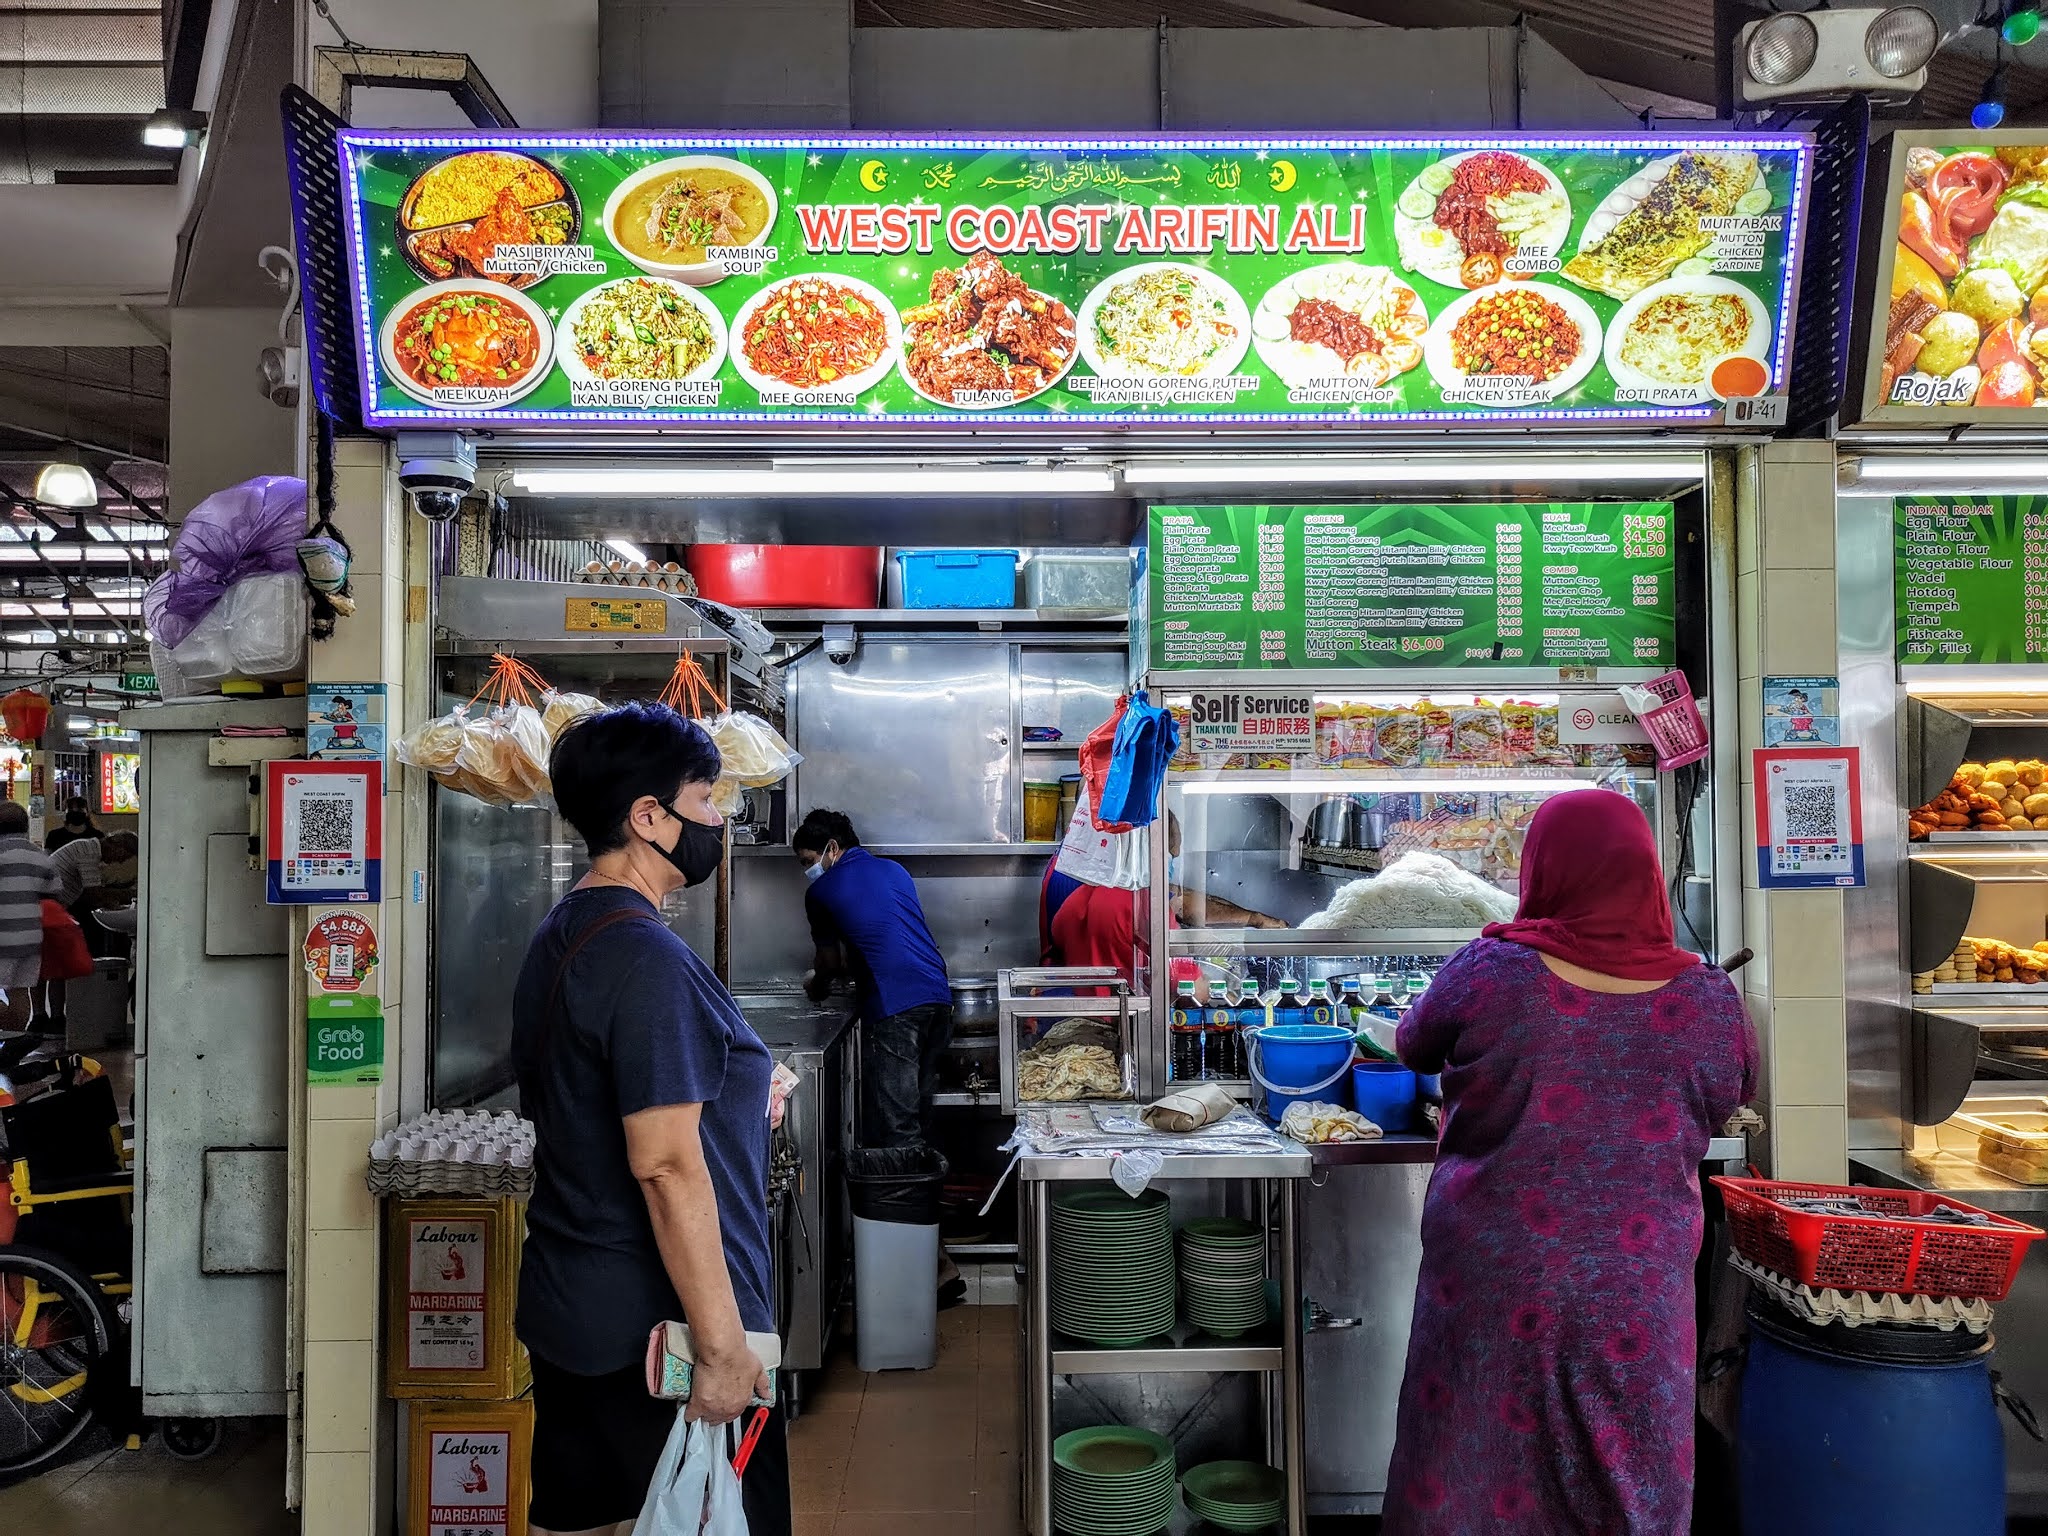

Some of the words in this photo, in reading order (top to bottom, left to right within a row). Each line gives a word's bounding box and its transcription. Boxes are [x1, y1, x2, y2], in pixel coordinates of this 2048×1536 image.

[1700, 217, 1781, 229] MURTABAK
[797, 206, 941, 251] WEST
[948, 206, 1110, 251] COAST
[1116, 206, 1278, 251] ARIFIN
[1286, 206, 1365, 250] ALI
[1718, 234, 1764, 243] MUTTON
[497, 246, 530, 258] NASI
[534, 246, 593, 258] BRIYANI
[708, 248, 776, 259] KAMBING
[1518, 246, 1549, 257] MEE
[1718, 248, 1763, 256] CHICKEN
[486, 260, 536, 272] Mutton
[550, 260, 605, 272] Chicken
[724, 261, 762, 273] SOUP
[1505, 259, 1561, 271] COMBO
[1717, 261, 1762, 270] SARDINE
[572, 380, 605, 392] NASI
[609, 380, 671, 392] GORENG
[675, 380, 721, 392] PUTEH
[1070, 378, 1096, 389] BEE
[1100, 378, 1144, 389] HOON
[1148, 378, 1208, 389] GORENG
[1212, 378, 1258, 389] PUTEH
[1309, 377, 1376, 389] MUTTON/
[1464, 376, 1532, 390] MUTTON/
[434, 388, 463, 400] MEE
[467, 388, 509, 400] KUAH
[1443, 390, 1504, 401] CHICKEN
[1507, 390, 1552, 401] STEAK
[1617, 389, 1649, 400] ROTI
[1653, 388, 1698, 400] PRATA
[1892, 376, 1970, 405] Rojak
[573, 394, 608, 405] IKAN
[612, 393, 650, 408] BILIS/
[655, 394, 717, 405] CHICKEN
[761, 392, 790, 403] MEE
[794, 392, 855, 403] GORENG
[955, 391, 1012, 402] TULANG
[1093, 391, 1127, 402] IKAN
[1173, 391, 1234, 402] CHICKEN
[1289, 391, 1350, 402] CHICKEN
[1354, 391, 1395, 402] CHOP
[1906, 506, 1948, 515] INDIAN
[1953, 505, 1993, 515] ROJAK
[1163, 516, 1194, 525] PRATA
[1304, 515, 1344, 523] GORENG
[1543, 514, 1570, 522] KUAH
[1624, 515, 1666, 528] $4.50
[1906, 517, 1930, 528] Egg
[1937, 516, 1969, 526] Flour
[1163, 526, 1185, 534] Plain
[1187, 526, 1210, 534] Prata
[1259, 524, 1284, 533] $1.00
[1543, 524, 1562, 532] Mee
[1563, 524, 1586, 532] Kuah
[1163, 536, 1181, 545] Egg
[1183, 536, 1206, 544] Prata
[1259, 534, 1284, 543] $1.50
[1906, 531, 1937, 541] Plain
[1943, 531, 1975, 541] Flour
[1906, 545, 1950, 555] Potato
[1957, 545, 1989, 554] Flour
[1907, 559, 1973, 570] Vegetable
[1980, 559, 2012, 568] Flour
[1543, 566, 1577, 574] COMBO
[1197, 574, 1204, 582] &
[1206, 575, 1223, 584] Egg
[1225, 574, 1249, 582] Prata
[1259, 573, 1284, 582] $2.50
[1543, 577, 1575, 585] Mutton
[1576, 577, 1599, 586] Chop
[1633, 576, 1658, 584] $6.00
[1907, 573, 1945, 583] Vadei
[1164, 584, 1184, 592] Coin
[1186, 584, 1209, 592] Prata
[1259, 583, 1285, 591] $3.00
[1907, 588, 1955, 598] Hotdog
[1326, 599, 1358, 608] Goreng
[1908, 602, 1959, 612] Tempeh
[1543, 608, 1567, 617] Kway
[1569, 608, 1593, 616] Teow
[1594, 608, 1625, 616] Combo
[1908, 615, 1940, 625] Tahu
[1165, 622, 1189, 630] SOUP
[1165, 632, 1203, 642] Kambing
[1204, 632, 1226, 641] Soup
[1261, 631, 1285, 640] $4.00
[1306, 630, 1333, 638] Maggi
[1334, 630, 1367, 638] Goreng
[1544, 628, 1580, 636] BRIYANI
[1908, 629, 1962, 639] Fishcake
[1165, 643, 1203, 652] Kambing
[1204, 642, 1225, 651] Soup
[1227, 641, 1246, 649] Kaki
[1261, 641, 1285, 650] $6.00
[1306, 638, 1353, 650] Mutton
[1360, 638, 1396, 650] Steak
[1402, 638, 1443, 651] $6.00
[1908, 643, 1933, 653] Fish
[1939, 643, 1971, 653] Fillet
[1307, 651, 1336, 660] Tulang
[1544, 649, 1578, 657] Chicken
[1580, 649, 1610, 658] briyani
[1634, 648, 1659, 657] $6.00
[1192, 694, 1240, 723] Self
[1244, 695, 1310, 714] Service
[1575, 714, 1592, 724] SG
[1597, 714, 1640, 725] CLEAN
[1195, 725, 1220, 735] THANK
[1221, 725, 1237, 735] YOU
[1243, 717, 1310, 735] 自助服務
[321, 920, 365, 935] $4,888
[318, 1025, 365, 1043] Grab
[318, 1043, 364, 1061] Food
[417, 1225, 478, 1243] Labour
[410, 1295, 483, 1309] MARGARINE
[438, 1438, 501, 1455] Labour
[431, 1508, 506, 1522] MARGARINE
